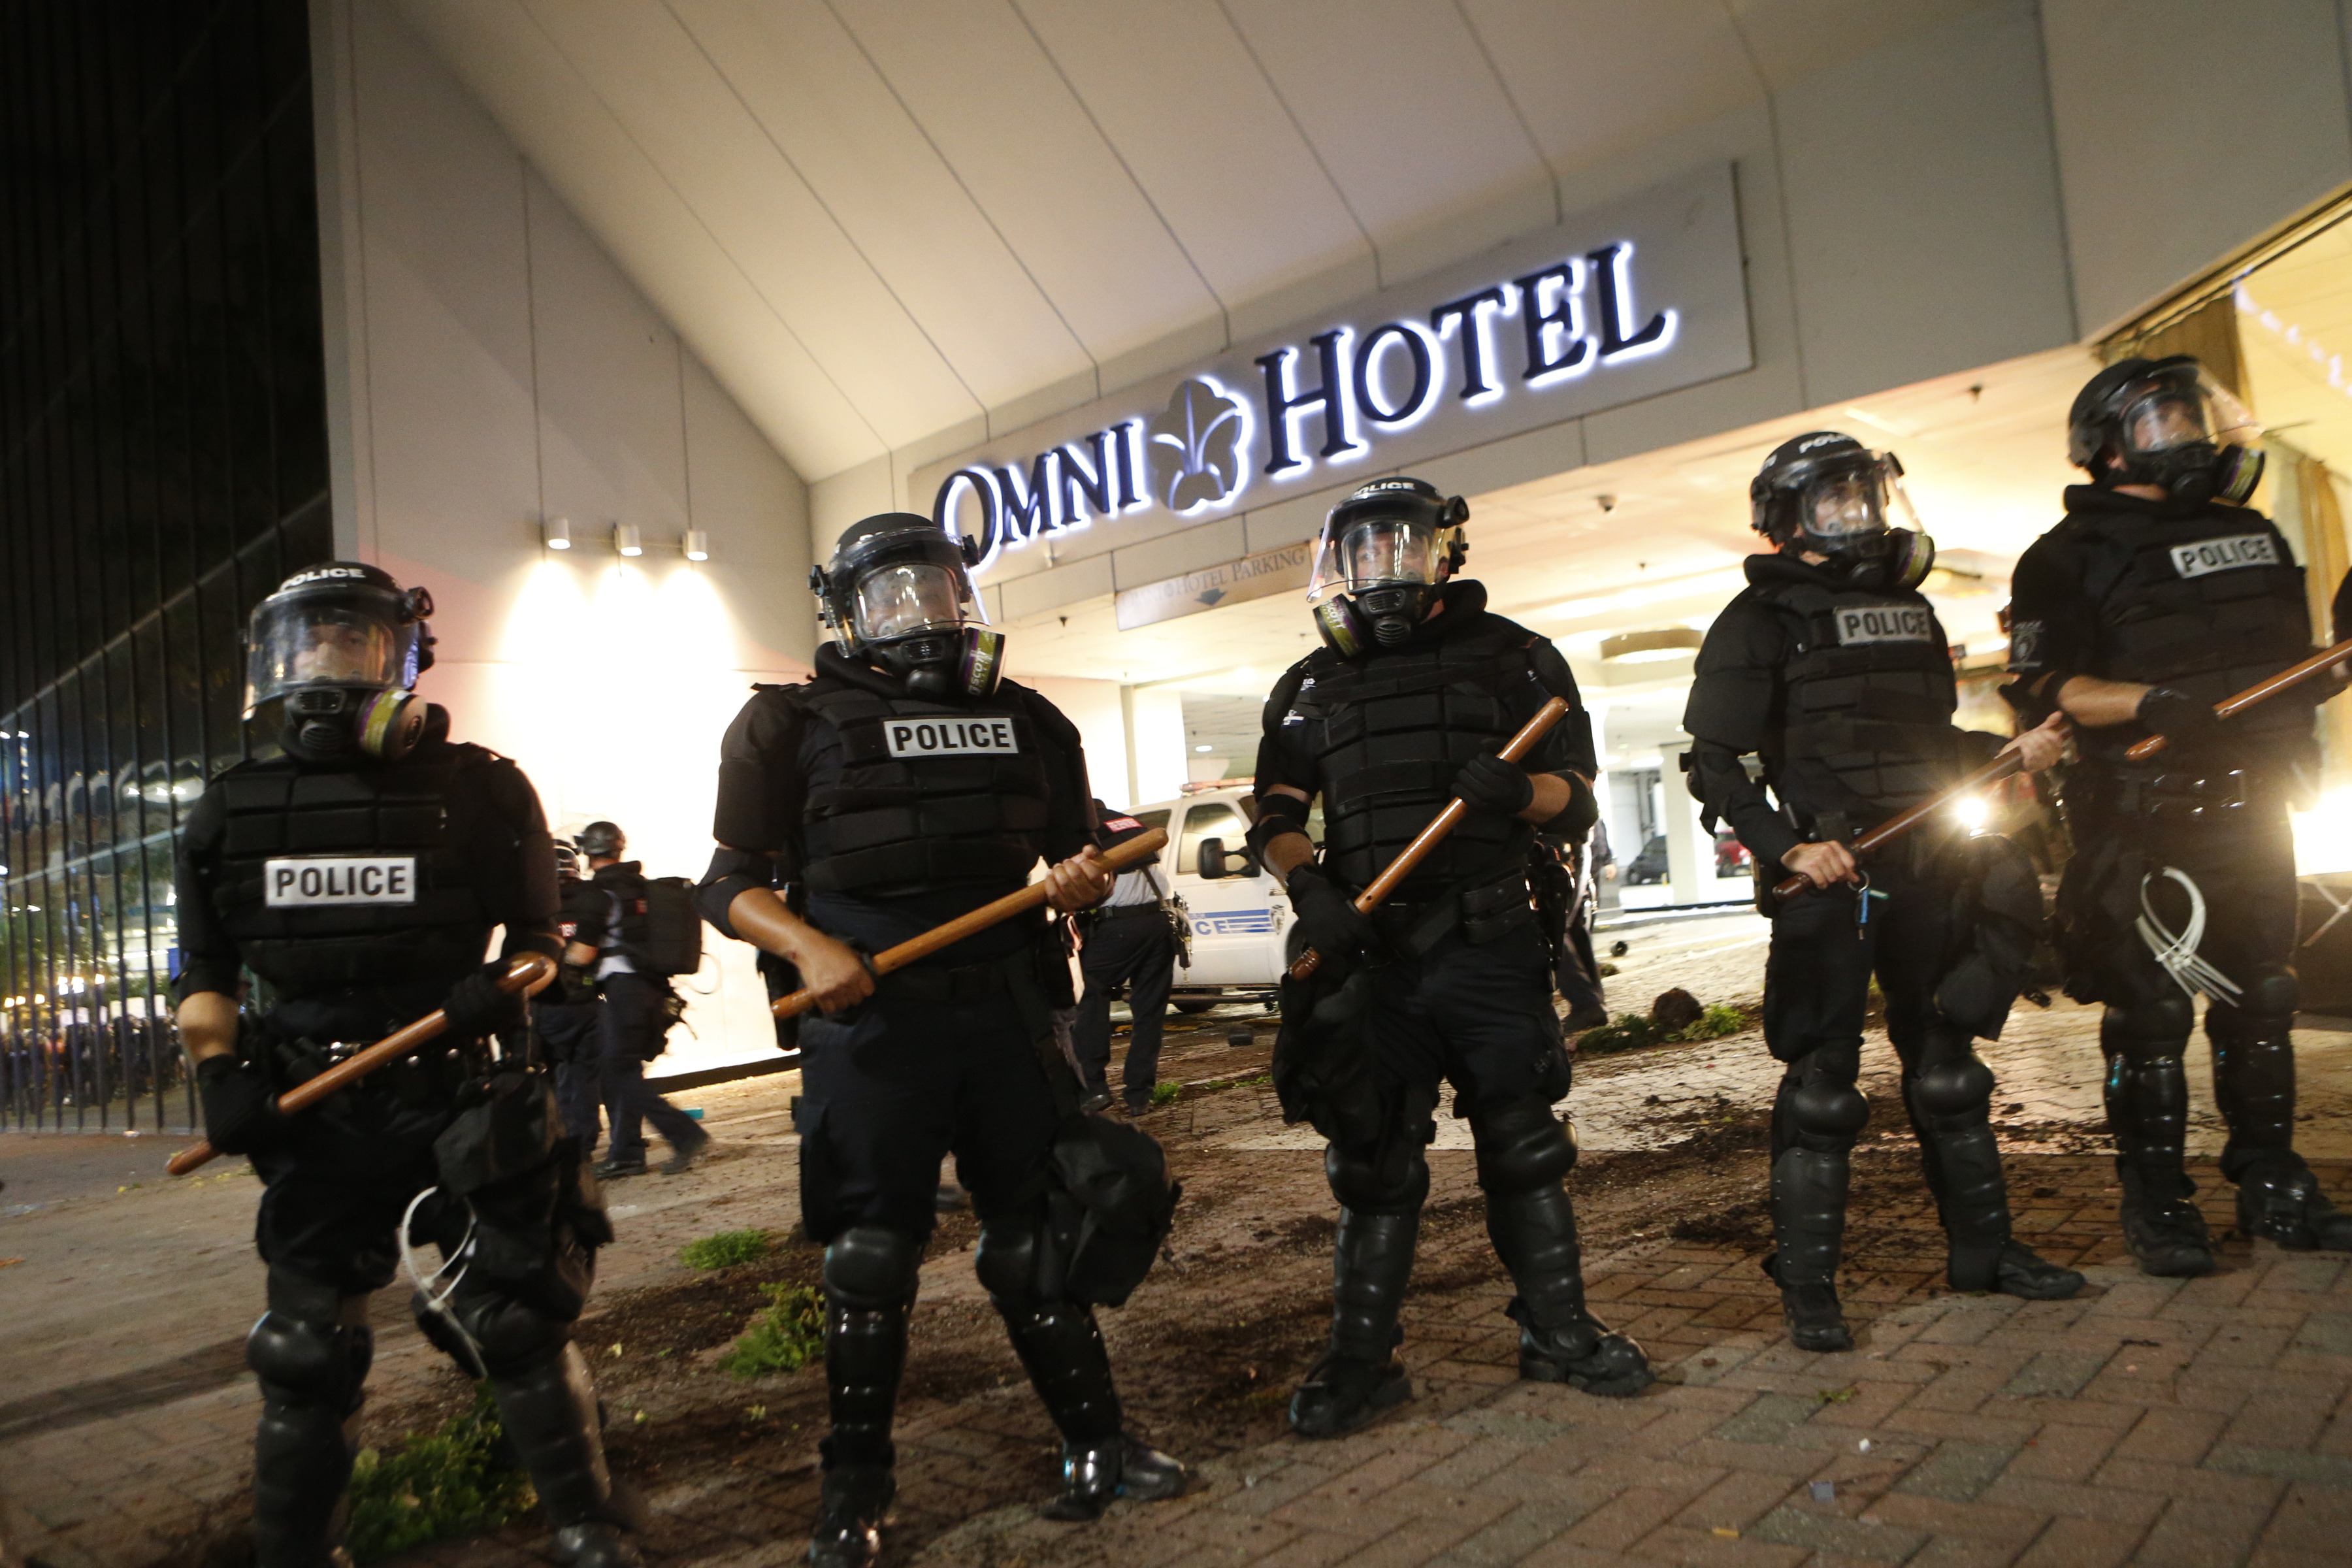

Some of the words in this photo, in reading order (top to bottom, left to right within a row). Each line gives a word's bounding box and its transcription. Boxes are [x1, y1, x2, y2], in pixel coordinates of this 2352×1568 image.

[932, 420, 1145, 570] OMNI
[1254, 243, 1673, 478] HOTEL
[1354, 482, 1415, 496] OLICE
[2181, 539, 2270, 573] POLICE
[280, 567, 367, 592] POLICE
[1177, 568, 1227, 595] HOTEL
[1231, 548, 1305, 581] PARKING
[1844, 611, 1928, 638] POLICE
[893, 723, 1011, 751] POLICE
[276, 866, 406, 897] POLICE
